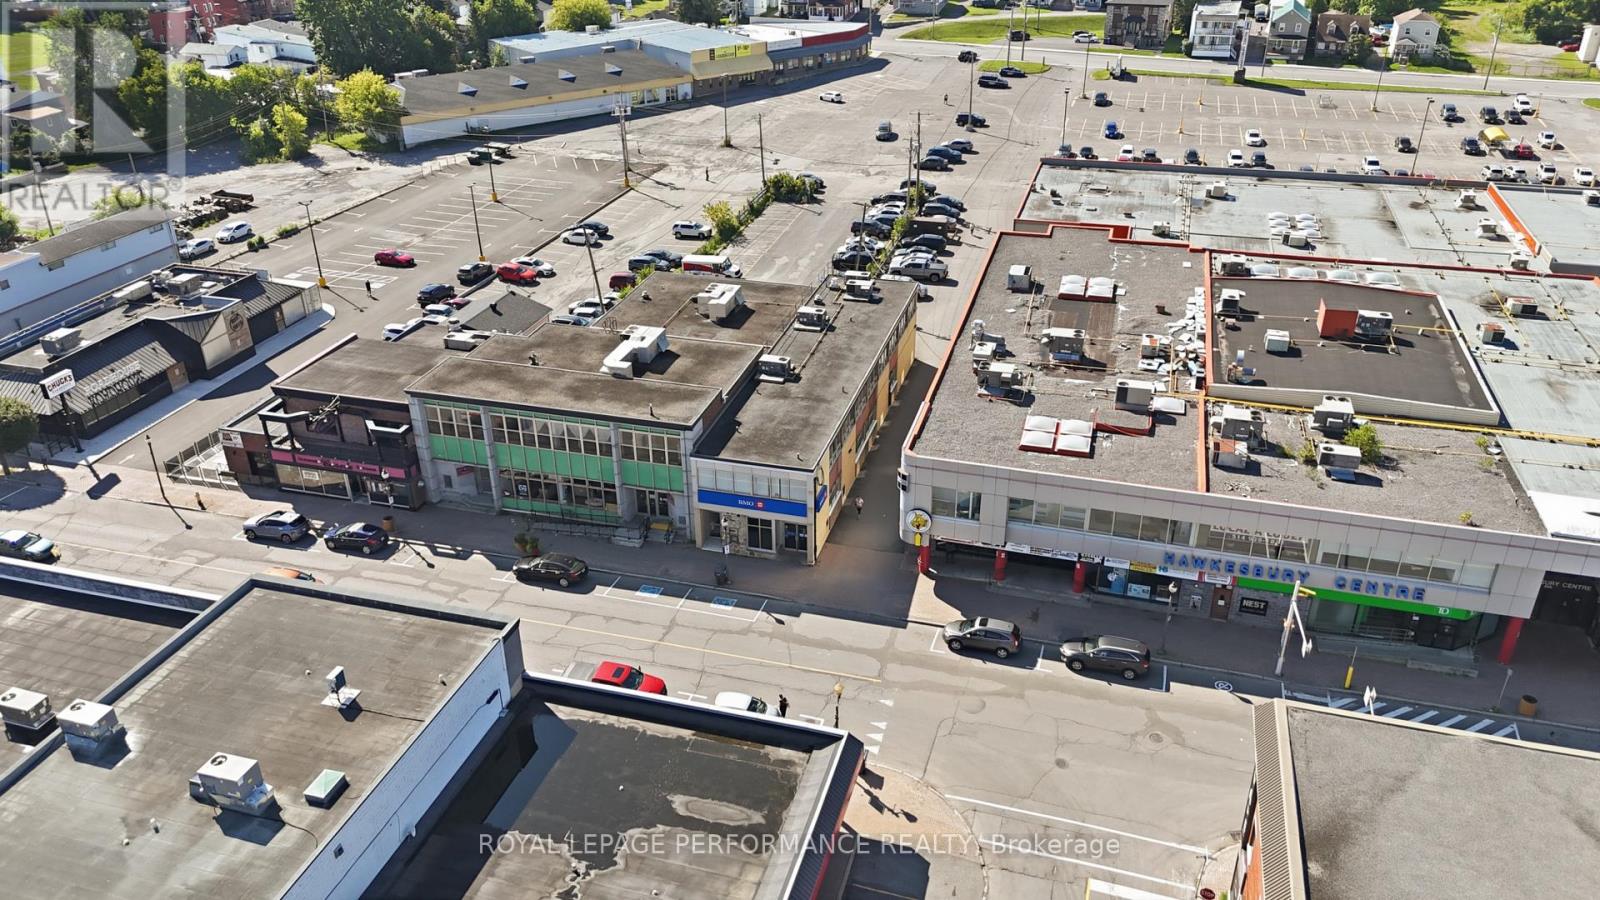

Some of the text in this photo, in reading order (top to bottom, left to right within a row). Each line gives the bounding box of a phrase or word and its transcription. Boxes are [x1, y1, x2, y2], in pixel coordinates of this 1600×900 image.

[738, 499, 754, 507] BMO
[1164, 552, 1310, 584] HAWKESBURY
[1334, 575, 1426, 601] CENTRE
[1242, 599, 1266, 609] NEST
[1438, 607, 1450, 615] TD
